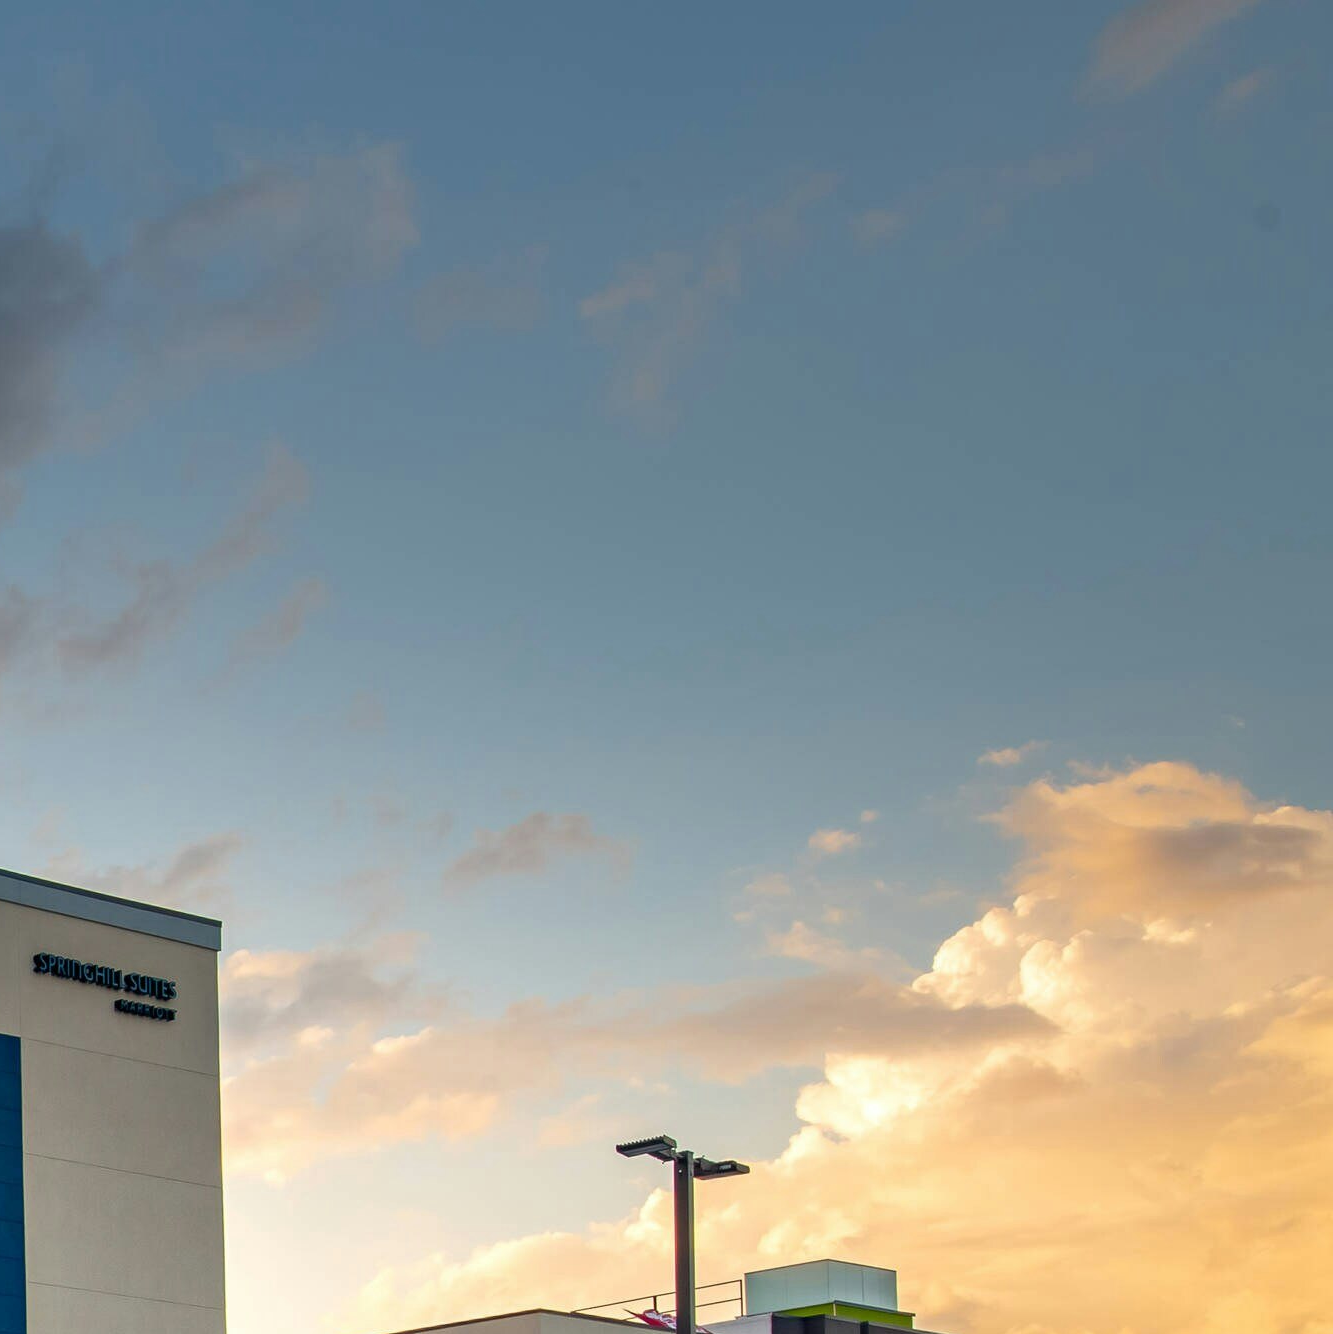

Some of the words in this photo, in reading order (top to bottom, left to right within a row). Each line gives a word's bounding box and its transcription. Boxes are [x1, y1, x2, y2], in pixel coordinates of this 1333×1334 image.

[33, 953, 125, 990] SPRINGHILL
[124, 972, 178, 1001] SUITES
[114, 999, 177, 1021] MARRIOTT
